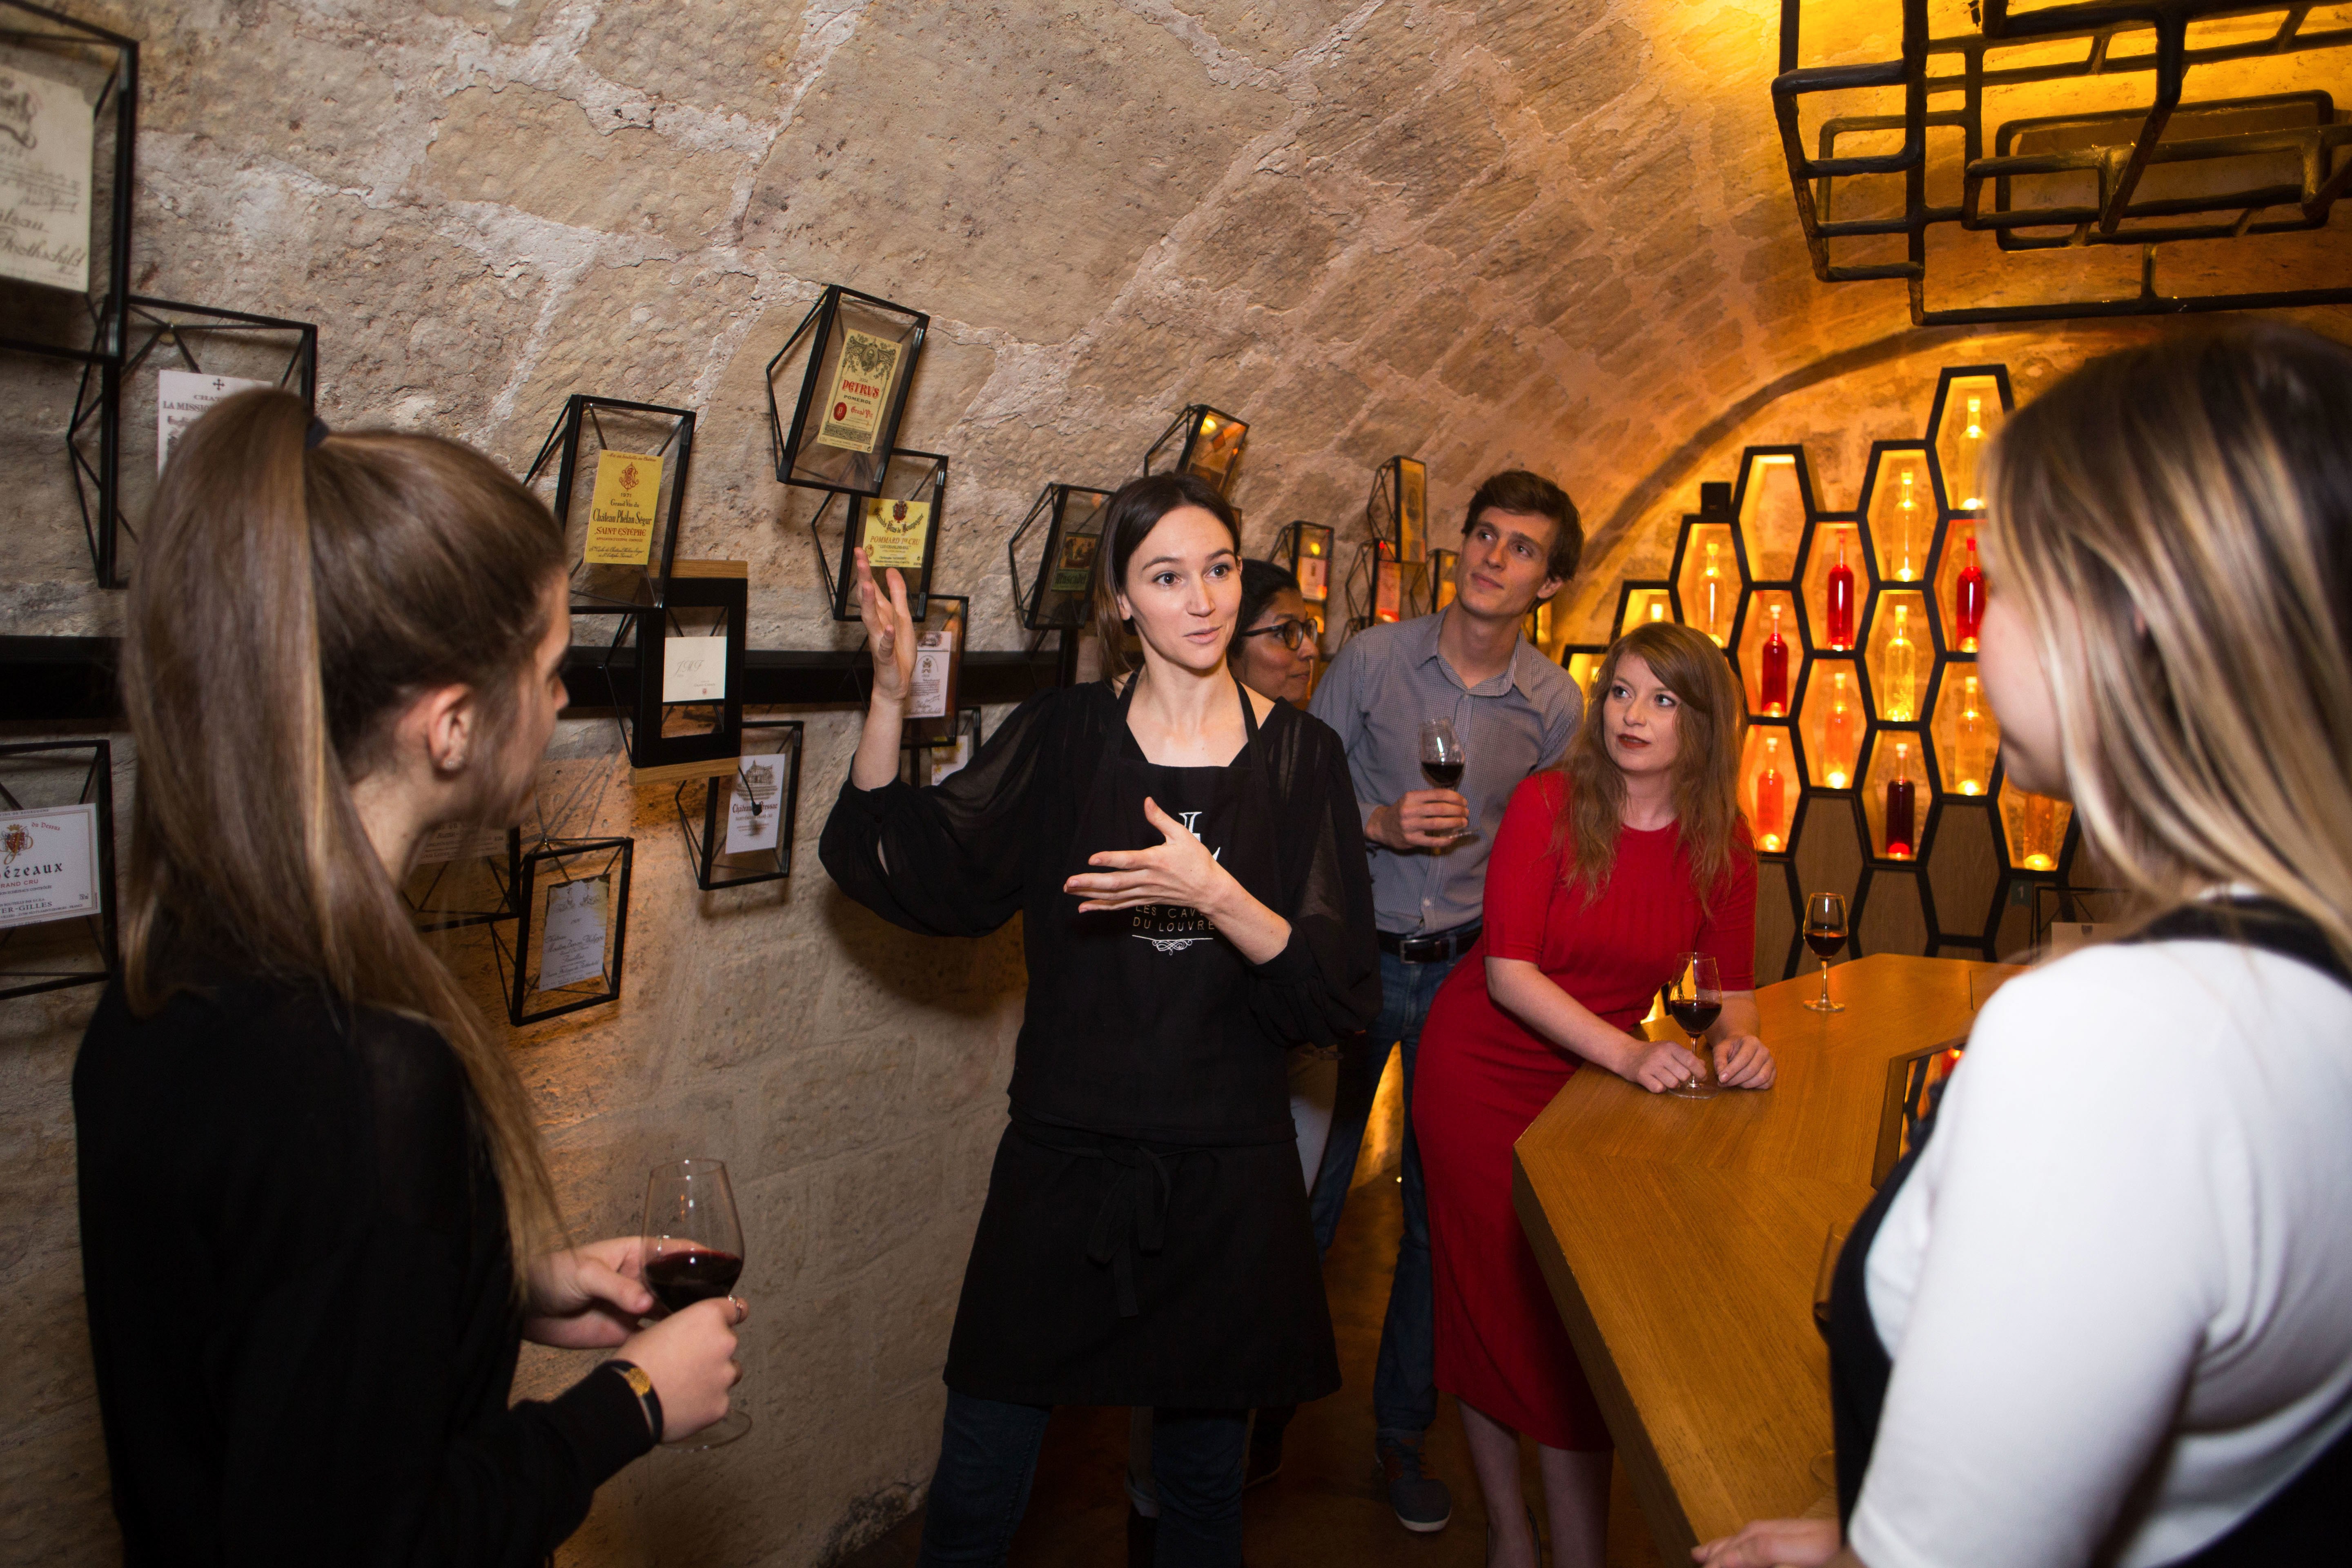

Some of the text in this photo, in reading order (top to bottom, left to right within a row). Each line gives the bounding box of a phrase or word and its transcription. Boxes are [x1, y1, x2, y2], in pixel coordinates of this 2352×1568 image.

[844, 395, 871, 404] POMEROL
[163, 401, 209, 412] LA MISSIO
[851, 406, 865, 416] Grand
[593, 508, 652, 526] Château Phélan Ségur
[595, 526, 617, 535] SAINT
[870, 536, 900, 544] POMMARD
[41, 822, 61, 831] Dessus
[0, 862, 63, 879] ézeaux
[0, 902, 53, 913] ER-GILLES
[1136, 904, 1200, 918] LES CAV
[1133, 917, 1215, 931] DU LOUVRE
